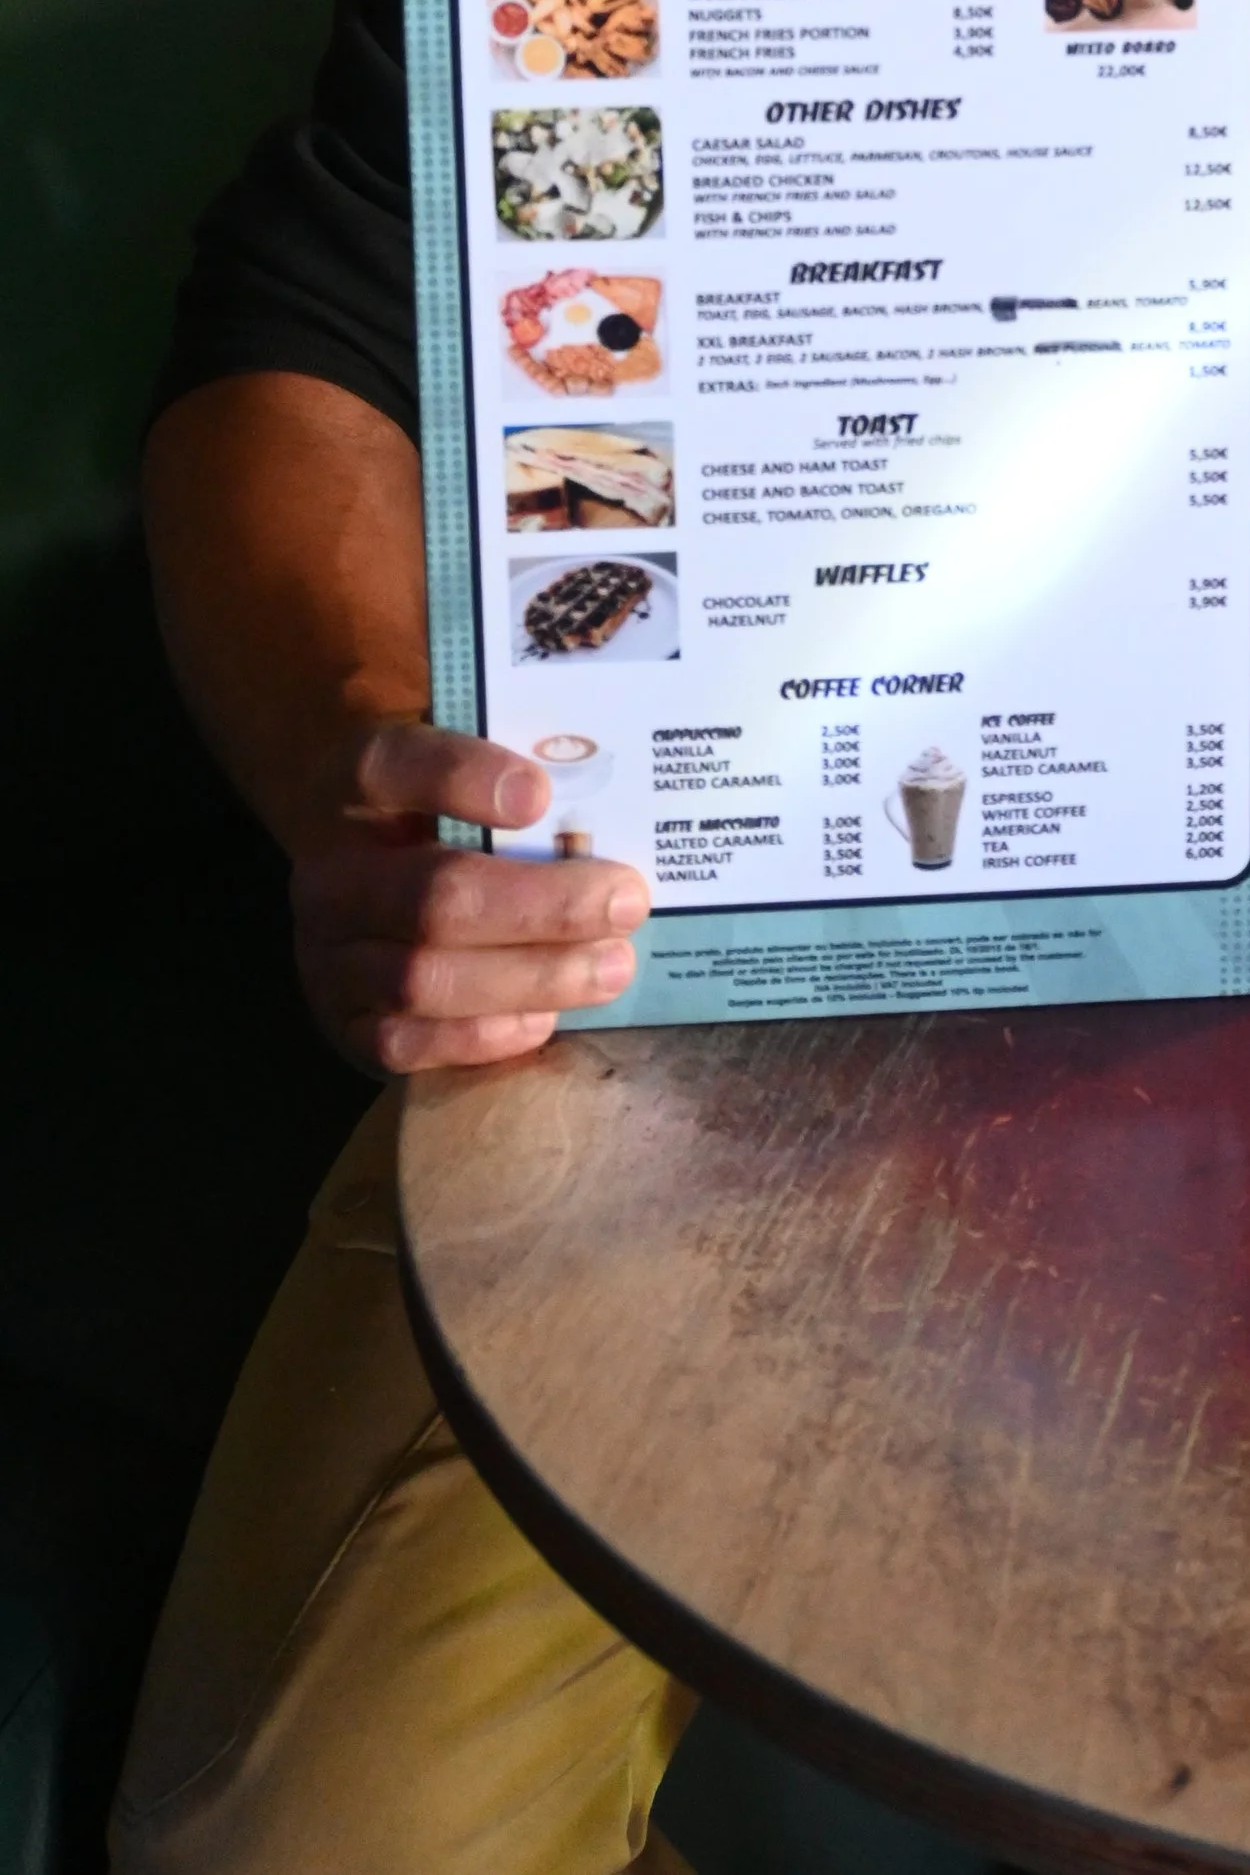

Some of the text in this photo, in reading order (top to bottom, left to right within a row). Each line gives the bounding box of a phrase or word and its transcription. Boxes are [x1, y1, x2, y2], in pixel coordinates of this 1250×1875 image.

[689, 7, 993, 22] NUGGETS 8,50€
[689, 29, 749, 43] FRENCH
[754, 28, 794, 41] FRIES
[799, 27, 869, 40] PORTION
[689, 45, 994, 61] FRENCH FRIES 4,90€
[725, 67, 765, 78] BACON
[770, 66, 793, 77] AND
[843, 64, 880, 75] SAUCE
[1097, 65, 1145, 78] 22,00€
[765, 97, 962, 125] OTHER DISHES
[692, 126, 1227, 152] CAESAR SALAD 8,50€
[789, 153, 845, 165] LETTUCE,
[1006, 147, 1048, 158] HOUSE
[1054, 146, 1093, 157] SAUCE
[693, 163, 1232, 189] BREADED CHICKEN 12,50€
[694, 189, 895, 203] WITH FRENCH FRIES AND SALAD
[694, 198, 1232, 224] FISH & CHIPS 12,50€
[694, 225, 896, 240] WITH FRENCH FRIES AND SALAD
[790, 259, 943, 285] BREAKFAST
[696, 292, 780, 306] BREAKFAST
[697, 309, 738, 322] TOAST,
[777, 307, 837, 319] SAUSAGE,
[843, 306, 887, 317] BACON,
[894, 304, 927, 315] HASH
[933, 303, 984, 315] BROWN,
[1135, 296, 1187, 307] TOMATO
[697, 337, 722, 350] XXL
[729, 334, 813, 348] BREAKFAST
[710, 355, 750, 367] TOAST,
[812, 351, 871, 363] SAUSAGE,
[876, 350, 922, 362] BACON,
[938, 348, 972, 359] HASH
[1179, 339, 1231, 350] TOMATO
[698, 381, 759, 394] EXTRAS:
[838, 413, 918, 437] TOAST
[812, 434, 961, 450] Served with fried chips
[701, 448, 1227, 477] CHEESE AND HAM TOAST 5,50€
[702, 471, 1227, 501] CHEESE AND BACON TOAST 5,50€
[703, 494, 1227, 525] CHEESE, TOMATO, ONION, OREGANO 5,50€
[814, 563, 929, 587] WAFFLES
[703, 578, 1227, 610] CHOCOLATE 3,90€
[708, 596, 1227, 628] HAZELNUT 3,90€
[780, 672, 965, 699] COFFEE CORNER
[981, 713, 1055, 728] ICE COFFEE
[821, 725, 860, 738] 2,50€
[981, 724, 1225, 745] VANILLA 3,50€
[652, 741, 860, 758] VANILLA 3,00€
[982, 740, 1225, 761] HAZELNUT 3,50€
[653, 758, 860, 775] HAZELNUT 3,00€
[982, 756, 1225, 778] SALTED CARAMEL 3,50€
[653, 774, 860, 791] SALTED CARAMEL 3,00€
[982, 783, 1224, 805] ESPRESSO 1,20€
[982, 799, 1224, 821] WHITE COFFEE 2,50€
[655, 820, 693, 834] LATTE
[823, 816, 861, 829] 3,00€
[982, 815, 1224, 837] AMERICAN 2,00€
[656, 832, 862, 850] SALTED CARAMEL 3,50€
[983, 831, 1224, 853] TEA 2,00€
[656, 849, 862, 866] HAZELNUT 3,50€
[983, 847, 1224, 869] IRISH COFFEE 6,00€
[656, 865, 863, 883] VANILLA 3,50€
